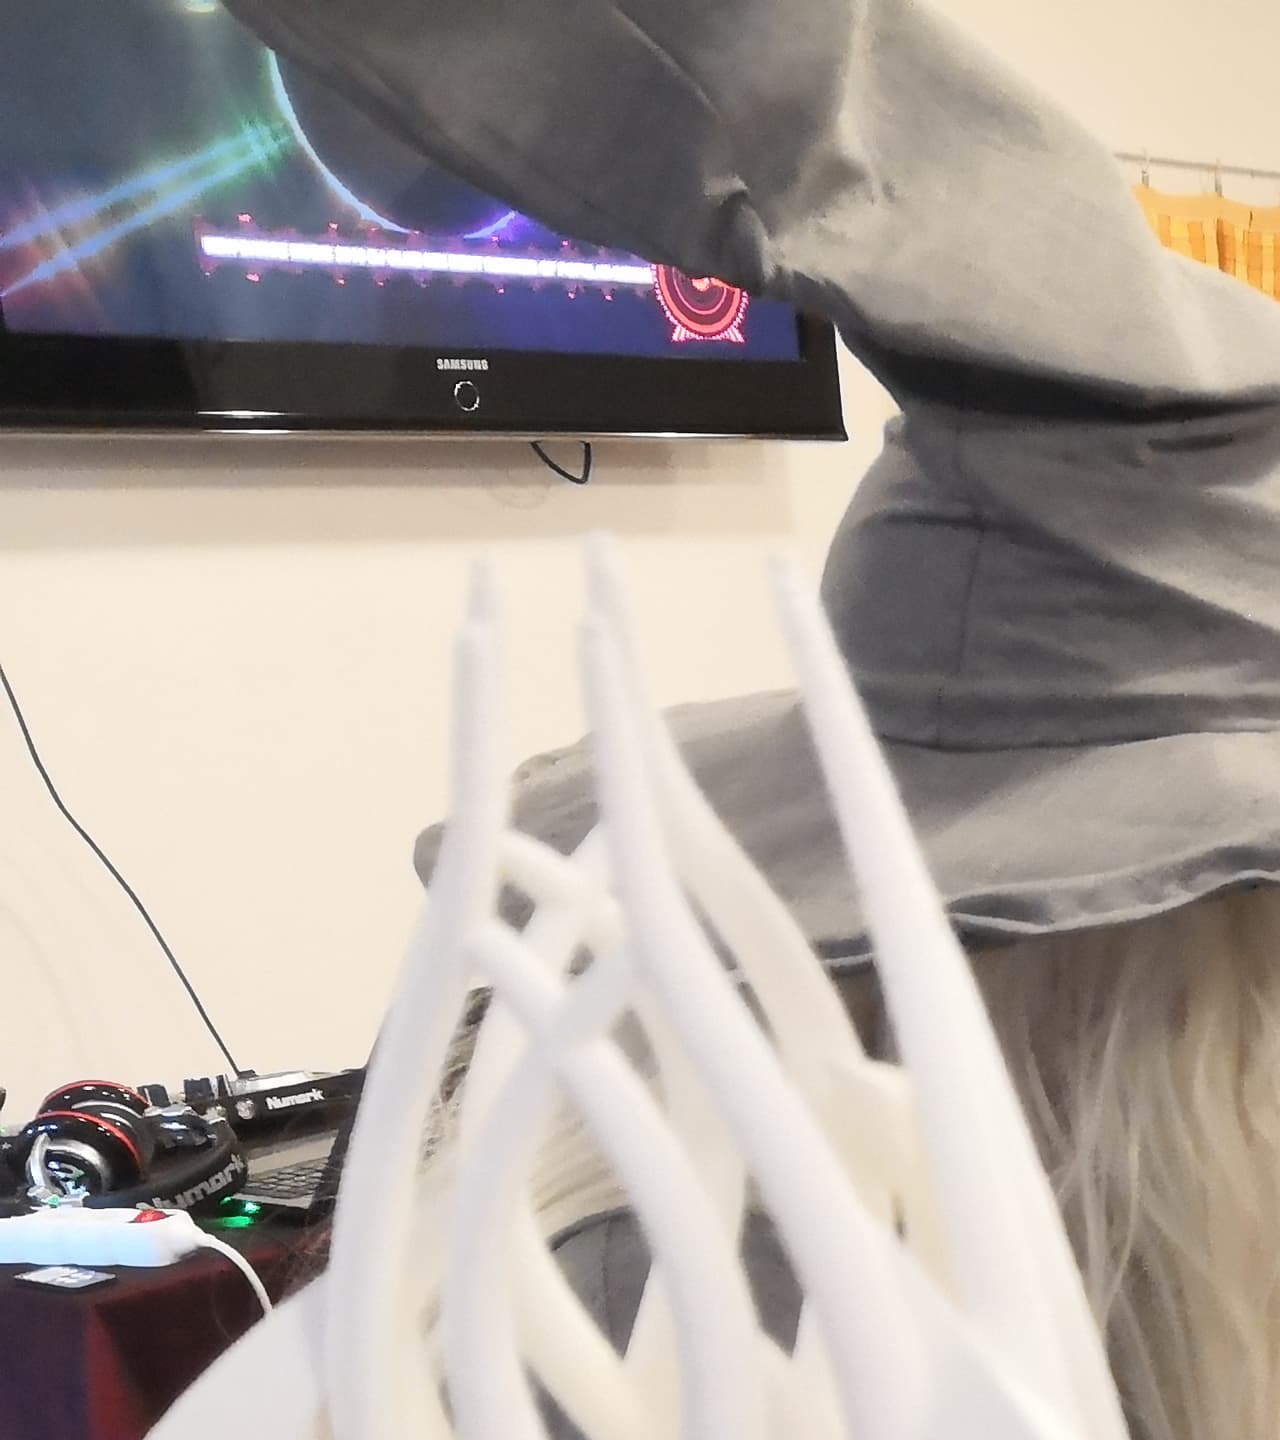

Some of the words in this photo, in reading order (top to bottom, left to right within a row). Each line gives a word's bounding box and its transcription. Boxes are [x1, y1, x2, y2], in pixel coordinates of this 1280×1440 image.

[436, 358, 489, 370] SAMSUNG
[265, 1088, 325, 1110] Numark
[136, 1152, 246, 1211] Numark
